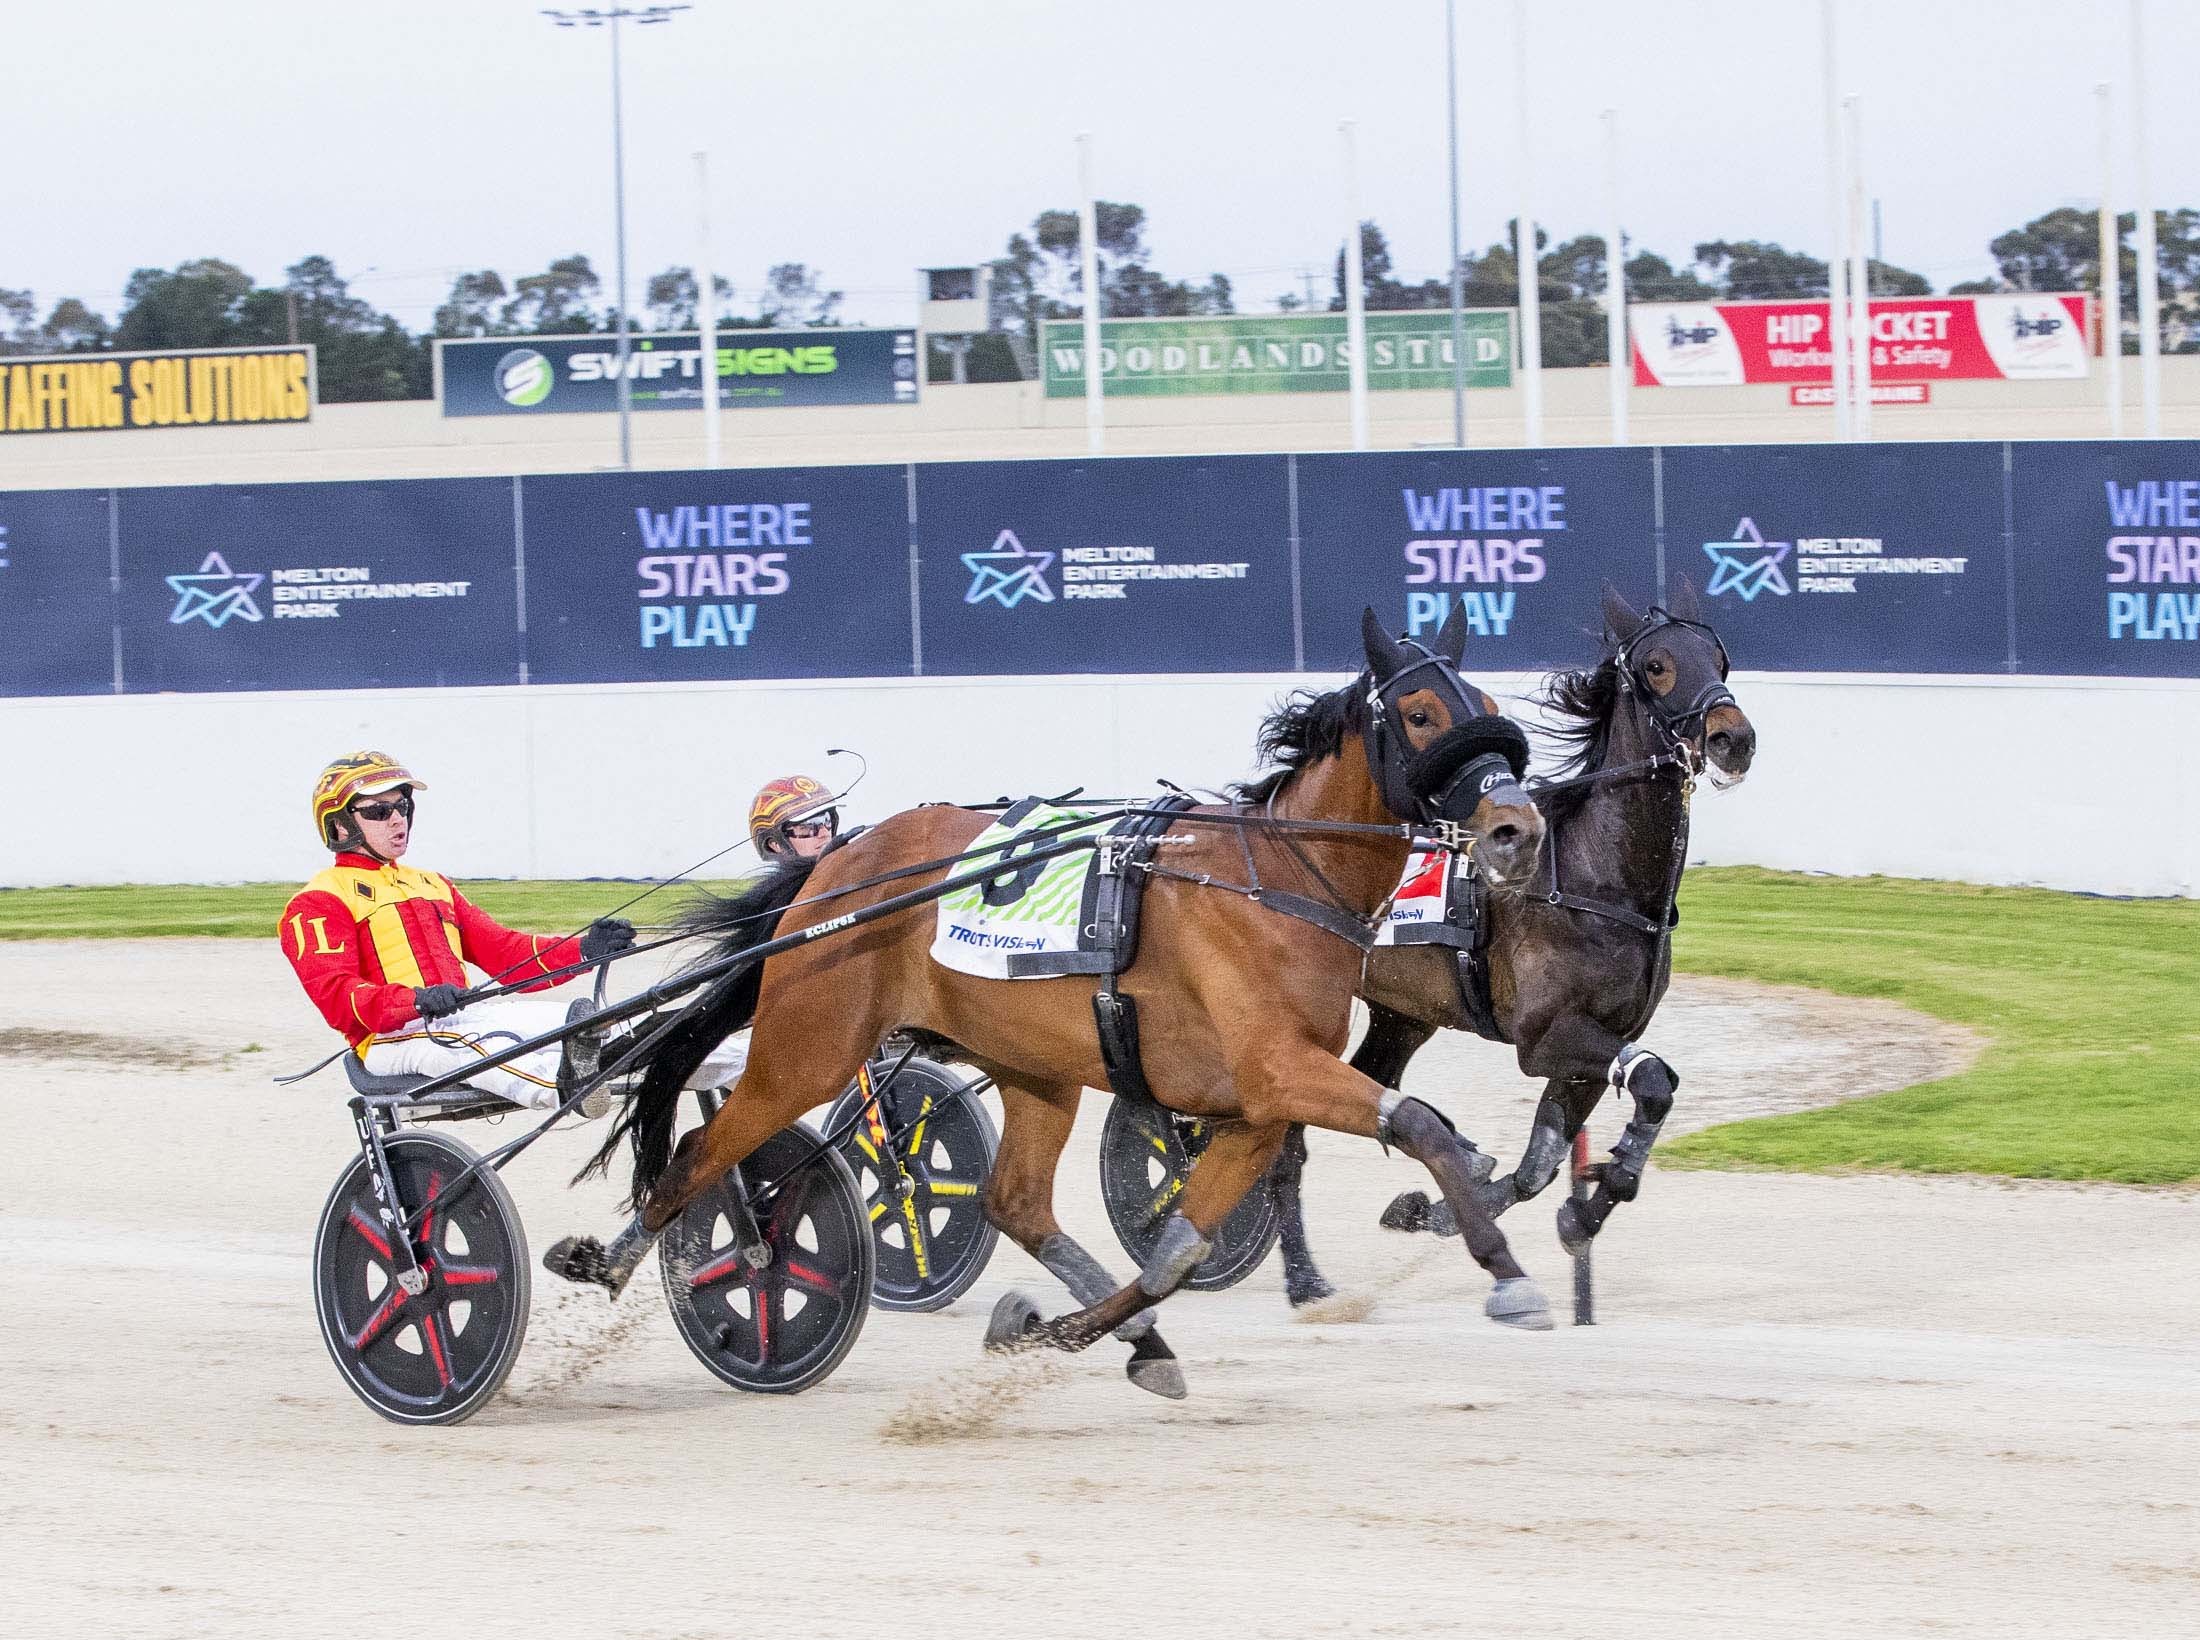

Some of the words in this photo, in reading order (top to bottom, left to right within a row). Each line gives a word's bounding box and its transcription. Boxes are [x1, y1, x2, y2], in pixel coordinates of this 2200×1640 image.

[1766, 314, 1823, 344] HIP
[1871, 311, 1952, 342] CKET
[129, 353, 309, 425] SOLUTIONS
[1402, 486, 1567, 531] WHERE
[635, 503, 813, 548] WHERE
[1062, 546, 1155, 562] MELTON
[1797, 538, 1882, 553] MELTON
[1404, 538, 1547, 584] STARS
[1797, 557, 1969, 574] ENTERTAINMENT
[272, 567, 370, 584] MELTON
[637, 552, 791, 598] STARS
[1062, 563, 1250, 581] ENTERTAINMENT
[273, 581, 472, 601] ENTERTAINMENT
[1063, 583, 1127, 599] PARK
[1798, 577, 1857, 592] PARK
[273, 603, 341, 618] PARK
[2107, 592, 2200, 640] PLAY
[640, 603, 757, 648] PLAY
